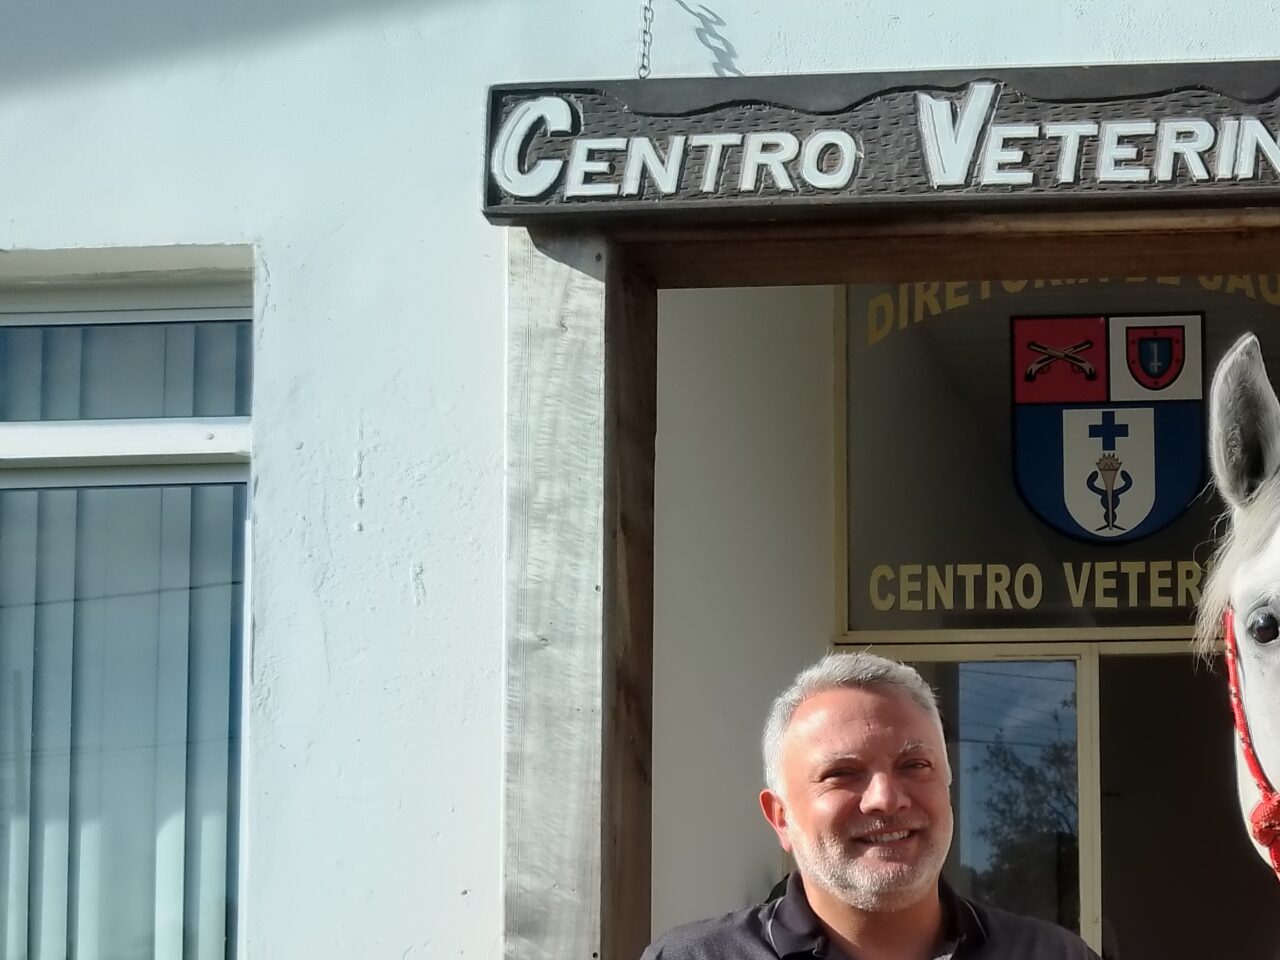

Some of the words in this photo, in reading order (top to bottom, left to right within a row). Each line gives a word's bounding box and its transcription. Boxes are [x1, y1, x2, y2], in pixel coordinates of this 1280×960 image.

[491, 96, 859, 197] CENTRO
[869, 563, 1043, 611] CENTRO
[1063, 560, 1203, 608] VETER
